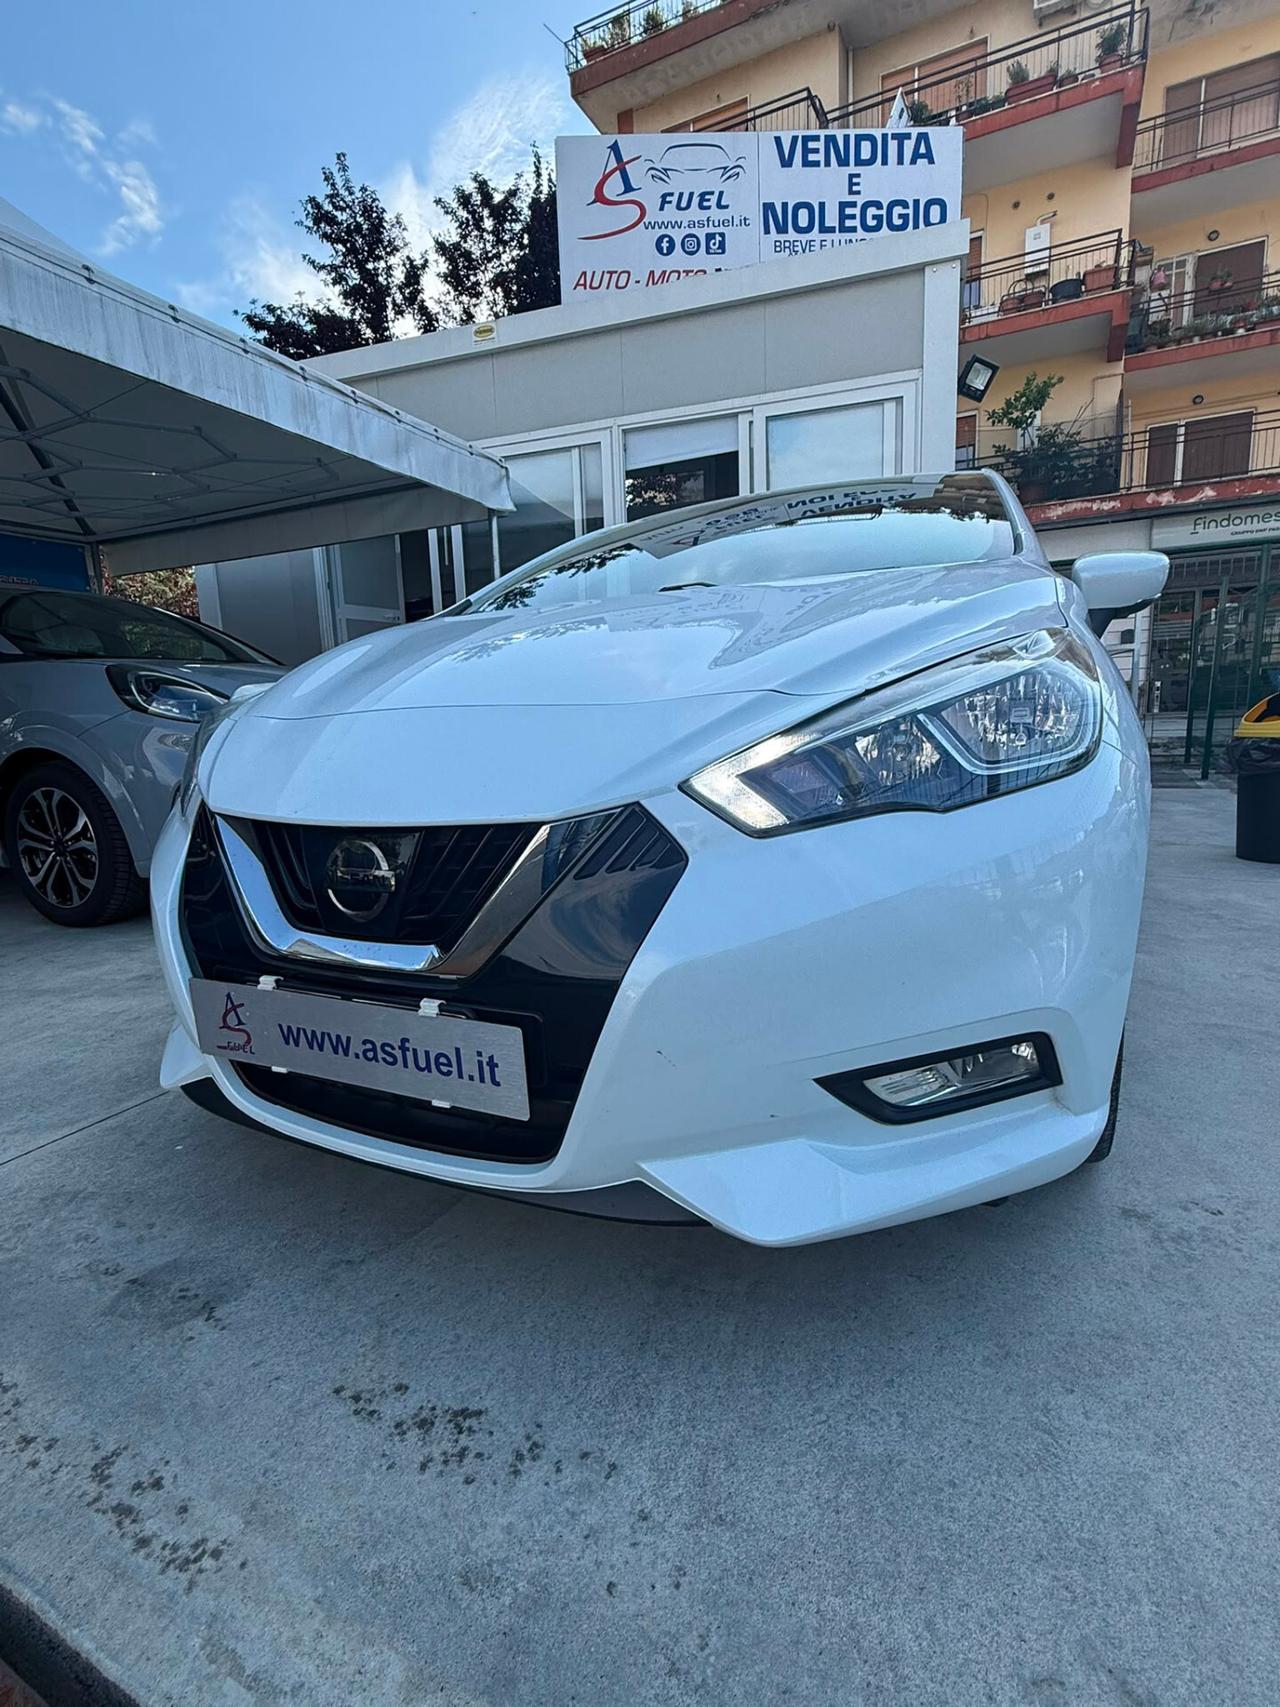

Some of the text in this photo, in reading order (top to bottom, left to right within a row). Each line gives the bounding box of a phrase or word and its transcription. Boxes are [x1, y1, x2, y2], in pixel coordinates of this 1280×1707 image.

[773, 131, 936, 169] VENDITA
[847, 173, 862, 196] E
[658, 190, 730, 212] FUEL
[643, 214, 751, 230] www.asfuel.it
[762, 197, 949, 236] NOLEGGIO
[773, 239, 816, 254] BREVE
[573, 270, 631, 291] AUTO
[645, 269, 707, 287] MO
[277, 1023, 501, 1087] www.asfuel.it
